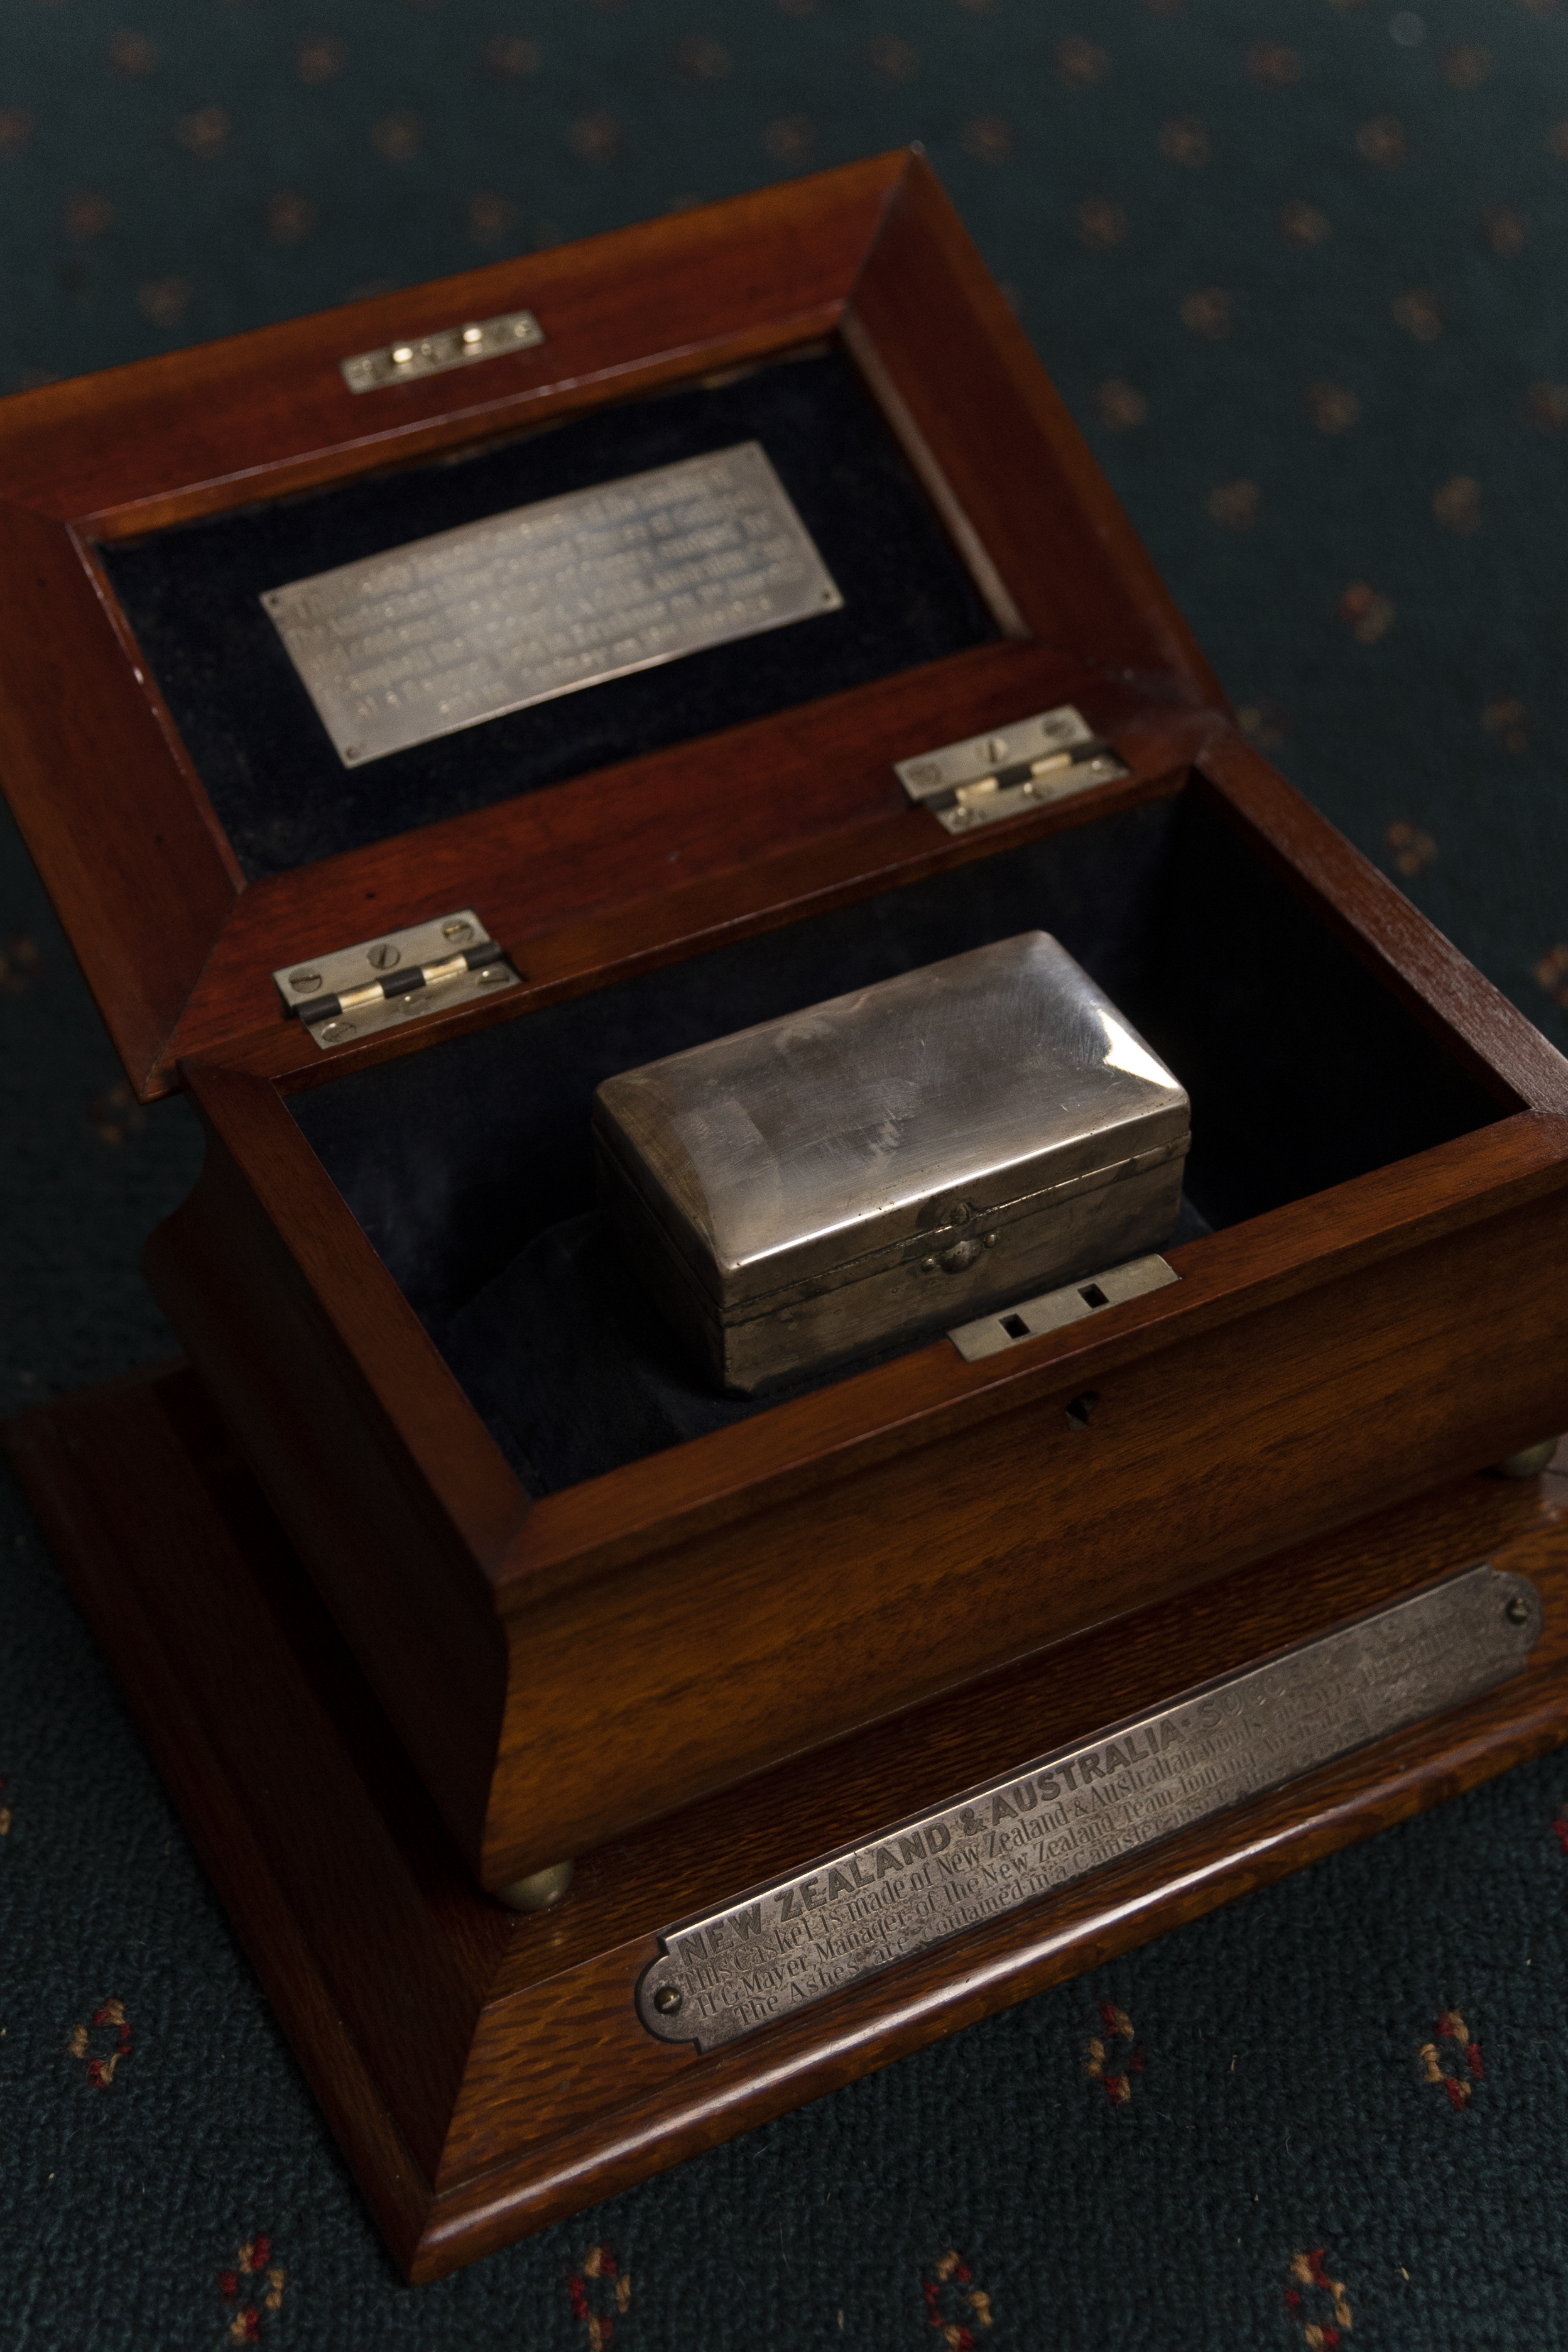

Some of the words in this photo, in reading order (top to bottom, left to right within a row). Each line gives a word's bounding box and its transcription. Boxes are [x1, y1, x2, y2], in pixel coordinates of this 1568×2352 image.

[677, 1903, 761, 1966] NEW
[775, 1823, 951, 1922] ZEALAND
[959, 1809, 986, 1836] &
[680, 1956, 732, 1995] This
[733, 1921, 813, 1971] Casket
[820, 1910, 842, 1937] is
[848, 1878, 907, 1926] made
[910, 1866, 934, 1896] of
[937, 1847, 980, 1883] New
[983, 1792, 1067, 1857] Zealand
[1073, 1799, 1090, 1817] &
[1090, 1741, 1195, 1810] Australian
[732, 1995, 779, 2028] The
[788, 1963, 860, 2006] Ashes
[874, 1937, 908, 1966] are
[1028, 1870, 1050, 1891] in
[1055, 1865, 1068, 1878] a
[742, 1954, 818, 1999] Mayer,
[817, 1915, 906, 1963] Manager
[915, 1891, 935, 1921] of
[941, 1876, 979, 1909] the
[981, 1854, 1028, 1885] New
[1037, 1811, 1116, 1863] Zealand
[1121, 1785, 1174, 1827] Team
